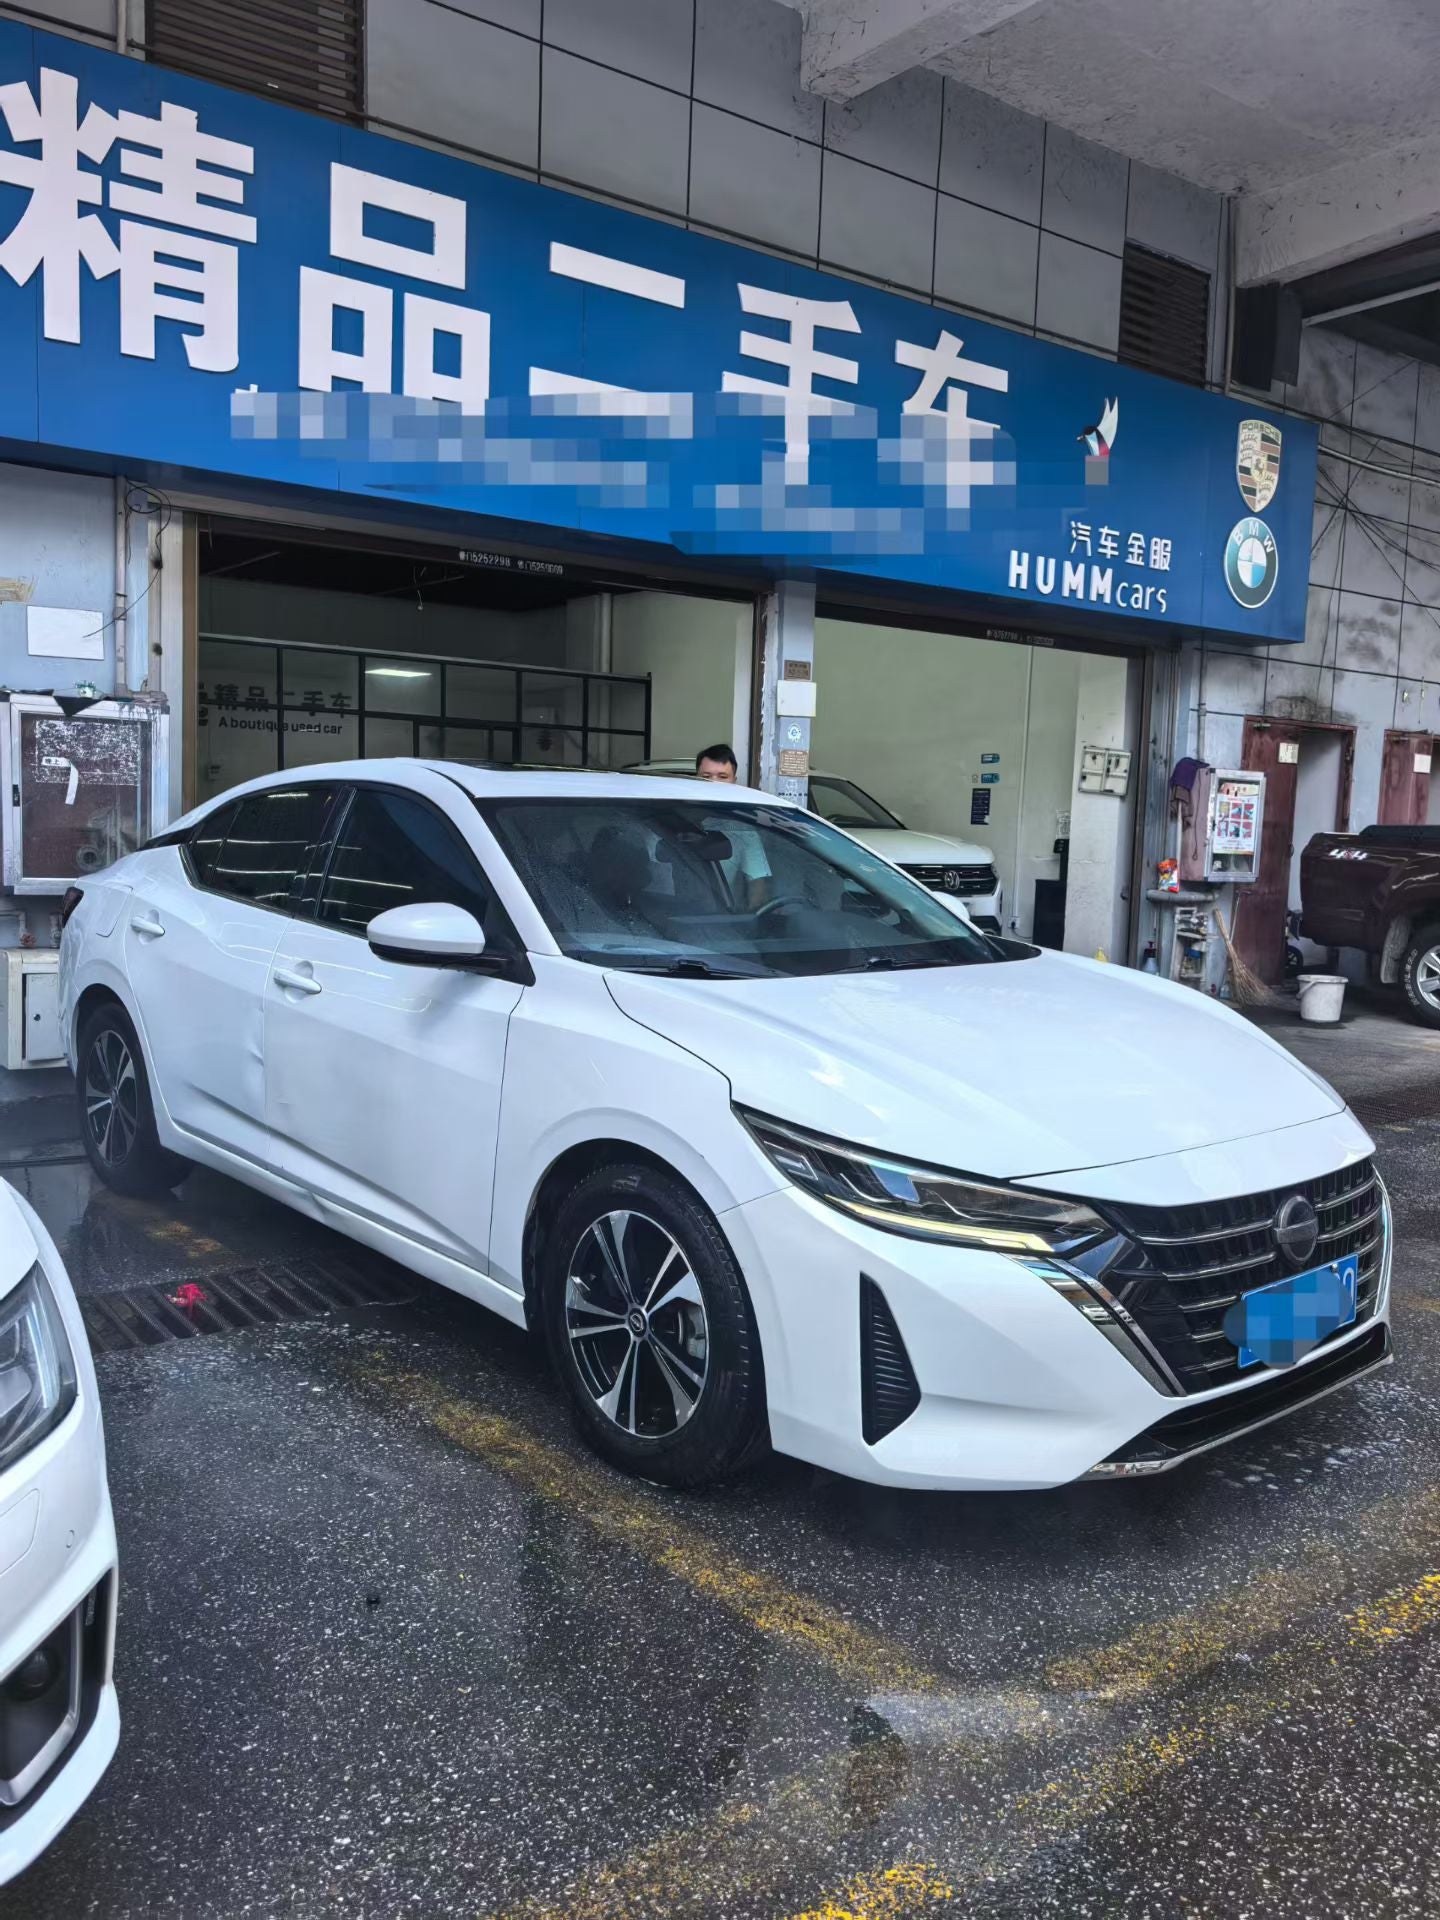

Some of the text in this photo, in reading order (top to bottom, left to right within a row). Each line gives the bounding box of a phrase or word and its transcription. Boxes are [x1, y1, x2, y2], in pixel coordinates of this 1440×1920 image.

[0, 67, 1008, 508] 精品二手车
[1241, 422, 1281, 441] PORSCHE
[1070, 520, 1172, 571] 汽车金服
[1233, 521, 1274, 553] BMW
[218, 716, 343, 734] A boutique used car
